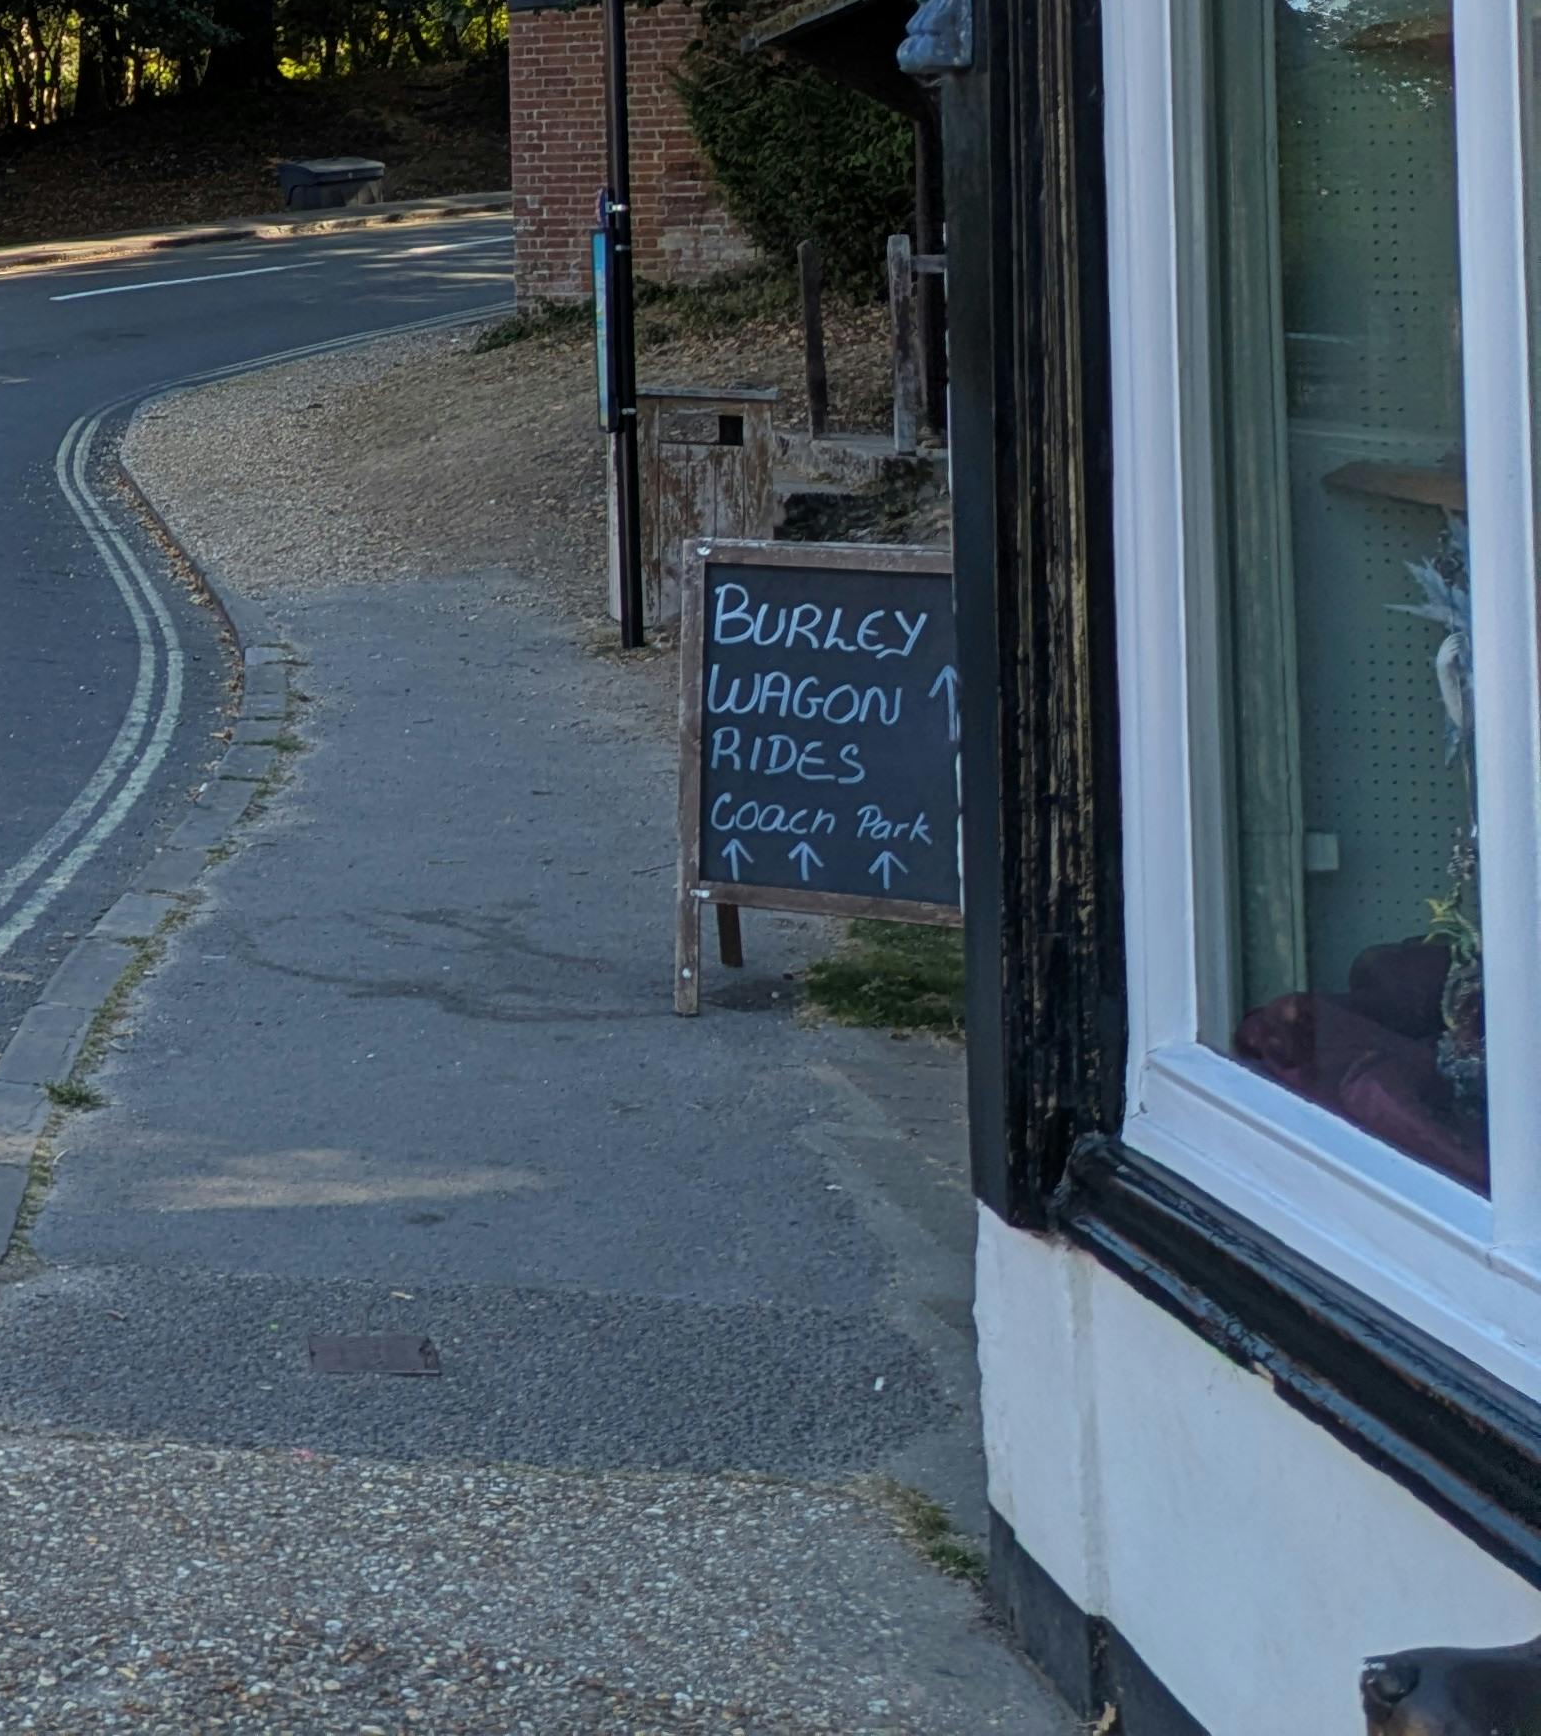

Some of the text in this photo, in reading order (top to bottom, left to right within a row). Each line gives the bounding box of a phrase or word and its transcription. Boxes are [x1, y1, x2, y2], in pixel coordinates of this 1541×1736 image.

[713, 582, 928, 660] BURLEY
[707, 662, 903, 726] WAGON
[710, 725, 867, 785] RIDES
[709, 791, 933, 846] Coach Park
